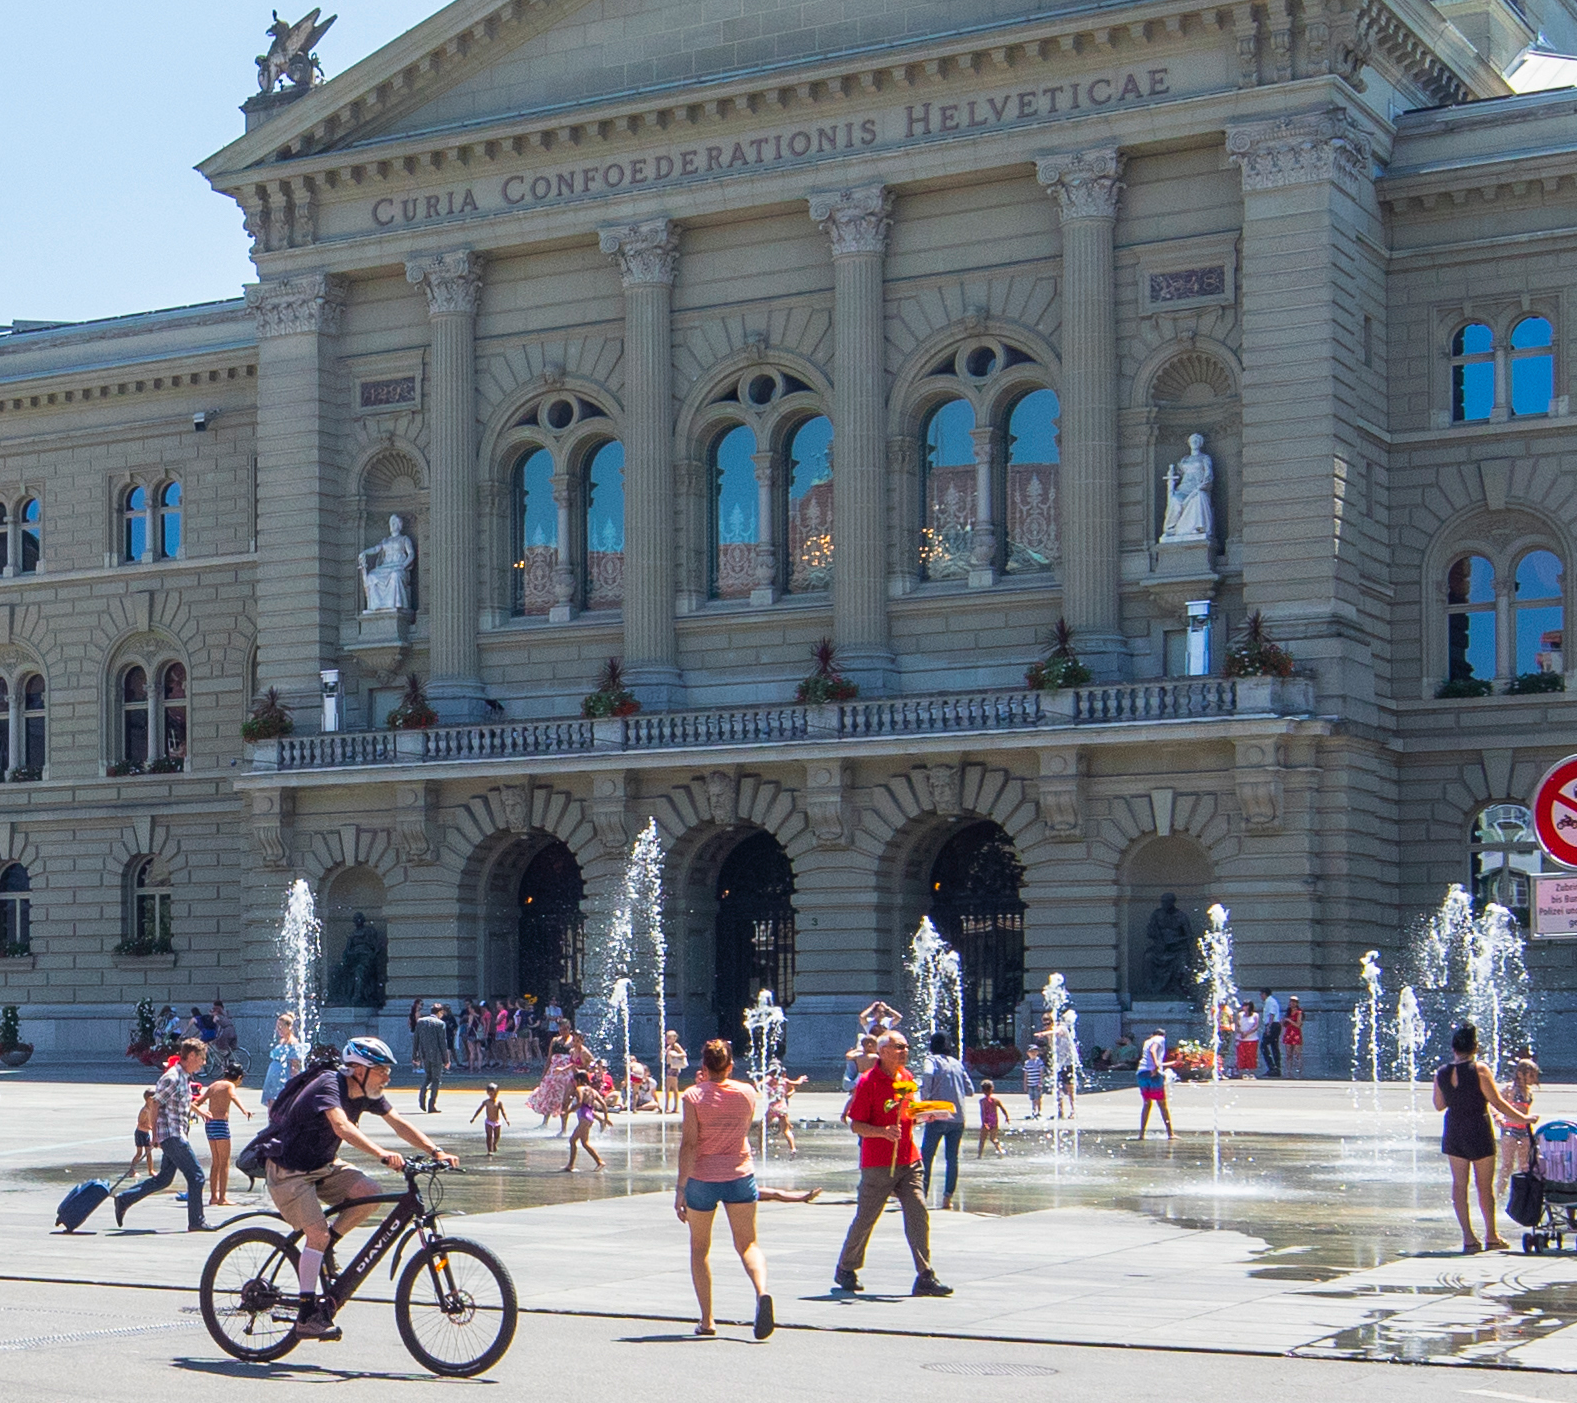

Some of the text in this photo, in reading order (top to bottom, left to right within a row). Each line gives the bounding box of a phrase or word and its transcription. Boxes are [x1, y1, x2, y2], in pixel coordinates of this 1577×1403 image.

[371, 67, 1170, 227] CURIA CONFOEDERATIONIS HELVETICAE
[1551, 895, 1562, 904] bis
[1539, 906, 1564, 916] Polizei
[811, 917, 819, 927] 3
[356, 1219, 400, 1273] DIAVELO
